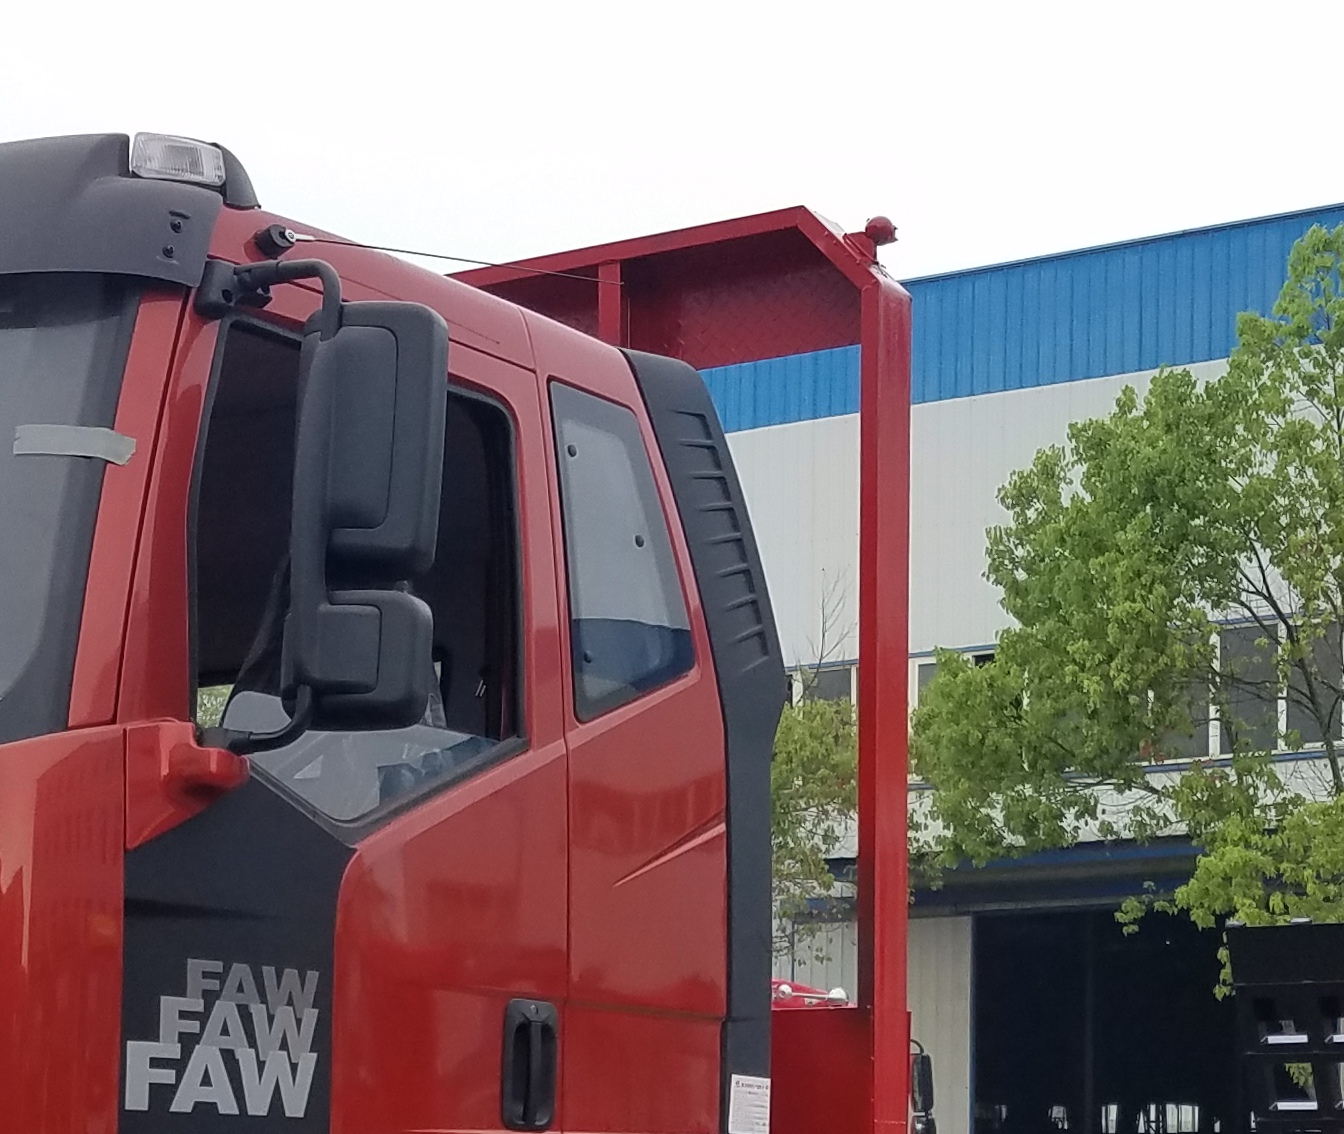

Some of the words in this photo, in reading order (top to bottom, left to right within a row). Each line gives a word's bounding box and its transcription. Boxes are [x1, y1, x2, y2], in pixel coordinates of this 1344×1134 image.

[186, 957, 320, 1018] FAW
[159, 995, 320, 1063] FAW
[124, 1040, 319, 1118] FAW
